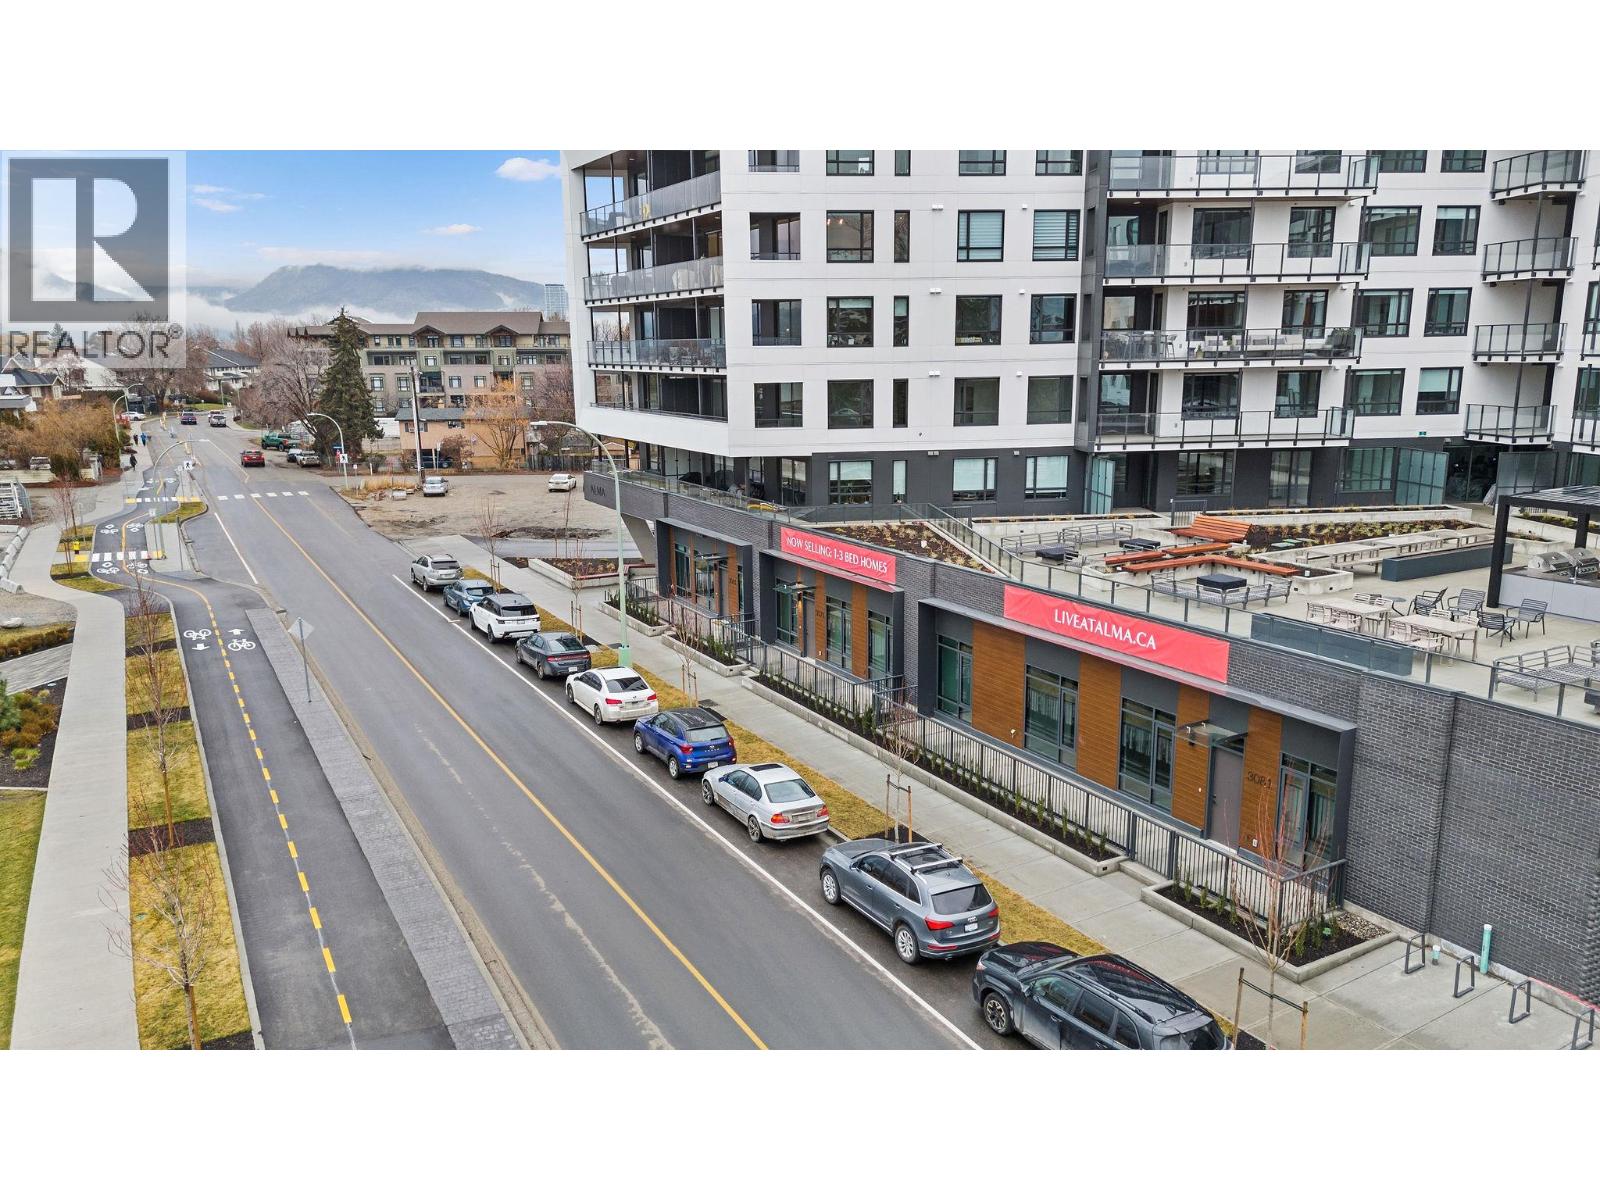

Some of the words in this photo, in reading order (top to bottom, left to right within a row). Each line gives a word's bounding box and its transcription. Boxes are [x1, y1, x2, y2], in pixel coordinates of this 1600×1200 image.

[786, 536, 803, 550] NOW
[804, 540, 832, 558] SELLING:
[833, 548, 844, 561] 1-3
[844, 552, 859, 566] BED
[860, 555, 888, 574] HOMES
[1054, 608, 1157, 650] LIVEATALMA.CA
